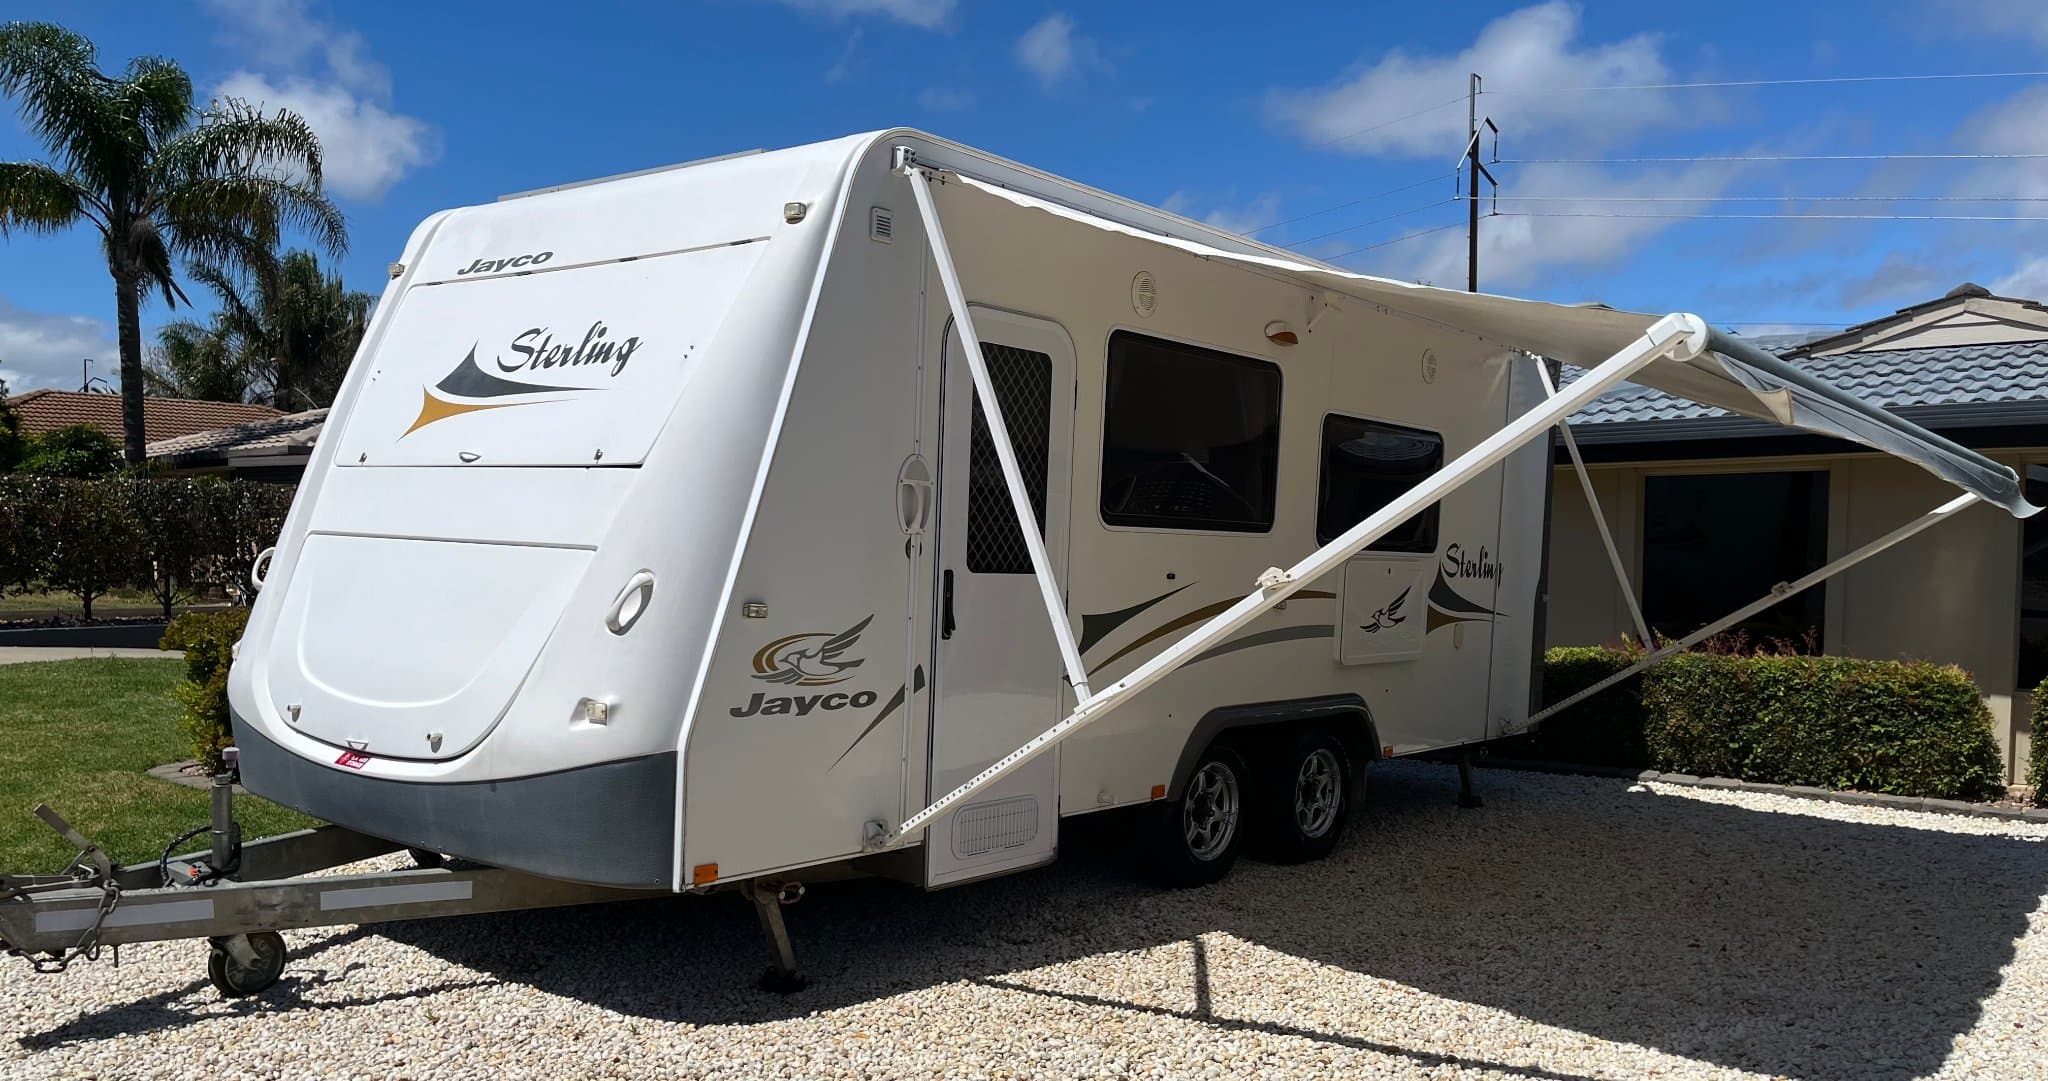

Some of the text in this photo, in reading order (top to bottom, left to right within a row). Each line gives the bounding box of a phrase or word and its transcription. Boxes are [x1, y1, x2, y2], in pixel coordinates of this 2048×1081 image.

[457, 251, 554, 275] Jayco
[497, 320, 644, 377] Sterling
[729, 690, 878, 718] Jayco
